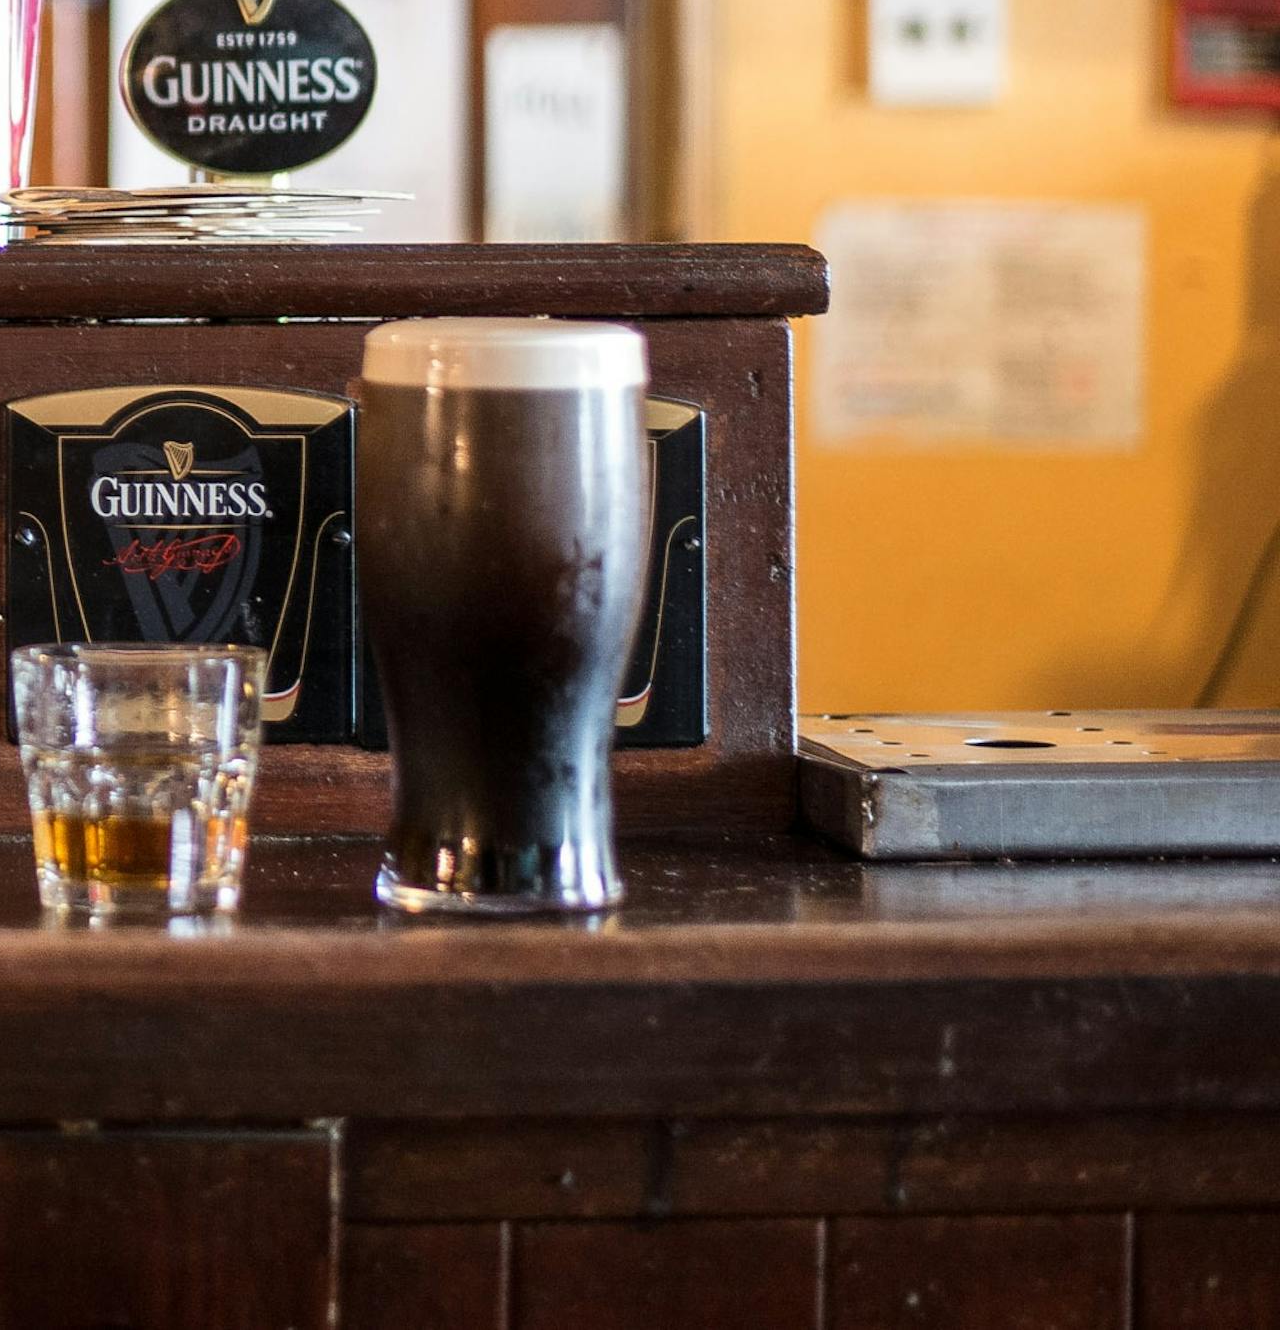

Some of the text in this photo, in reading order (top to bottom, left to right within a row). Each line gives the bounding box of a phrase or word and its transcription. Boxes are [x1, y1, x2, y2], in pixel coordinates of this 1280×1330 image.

[258, 30, 298, 46] 1759
[143, 53, 361, 106] GUINNESS
[187, 110, 329, 134] DRAUGHT
[91, 475, 267, 518] GUINNESS
